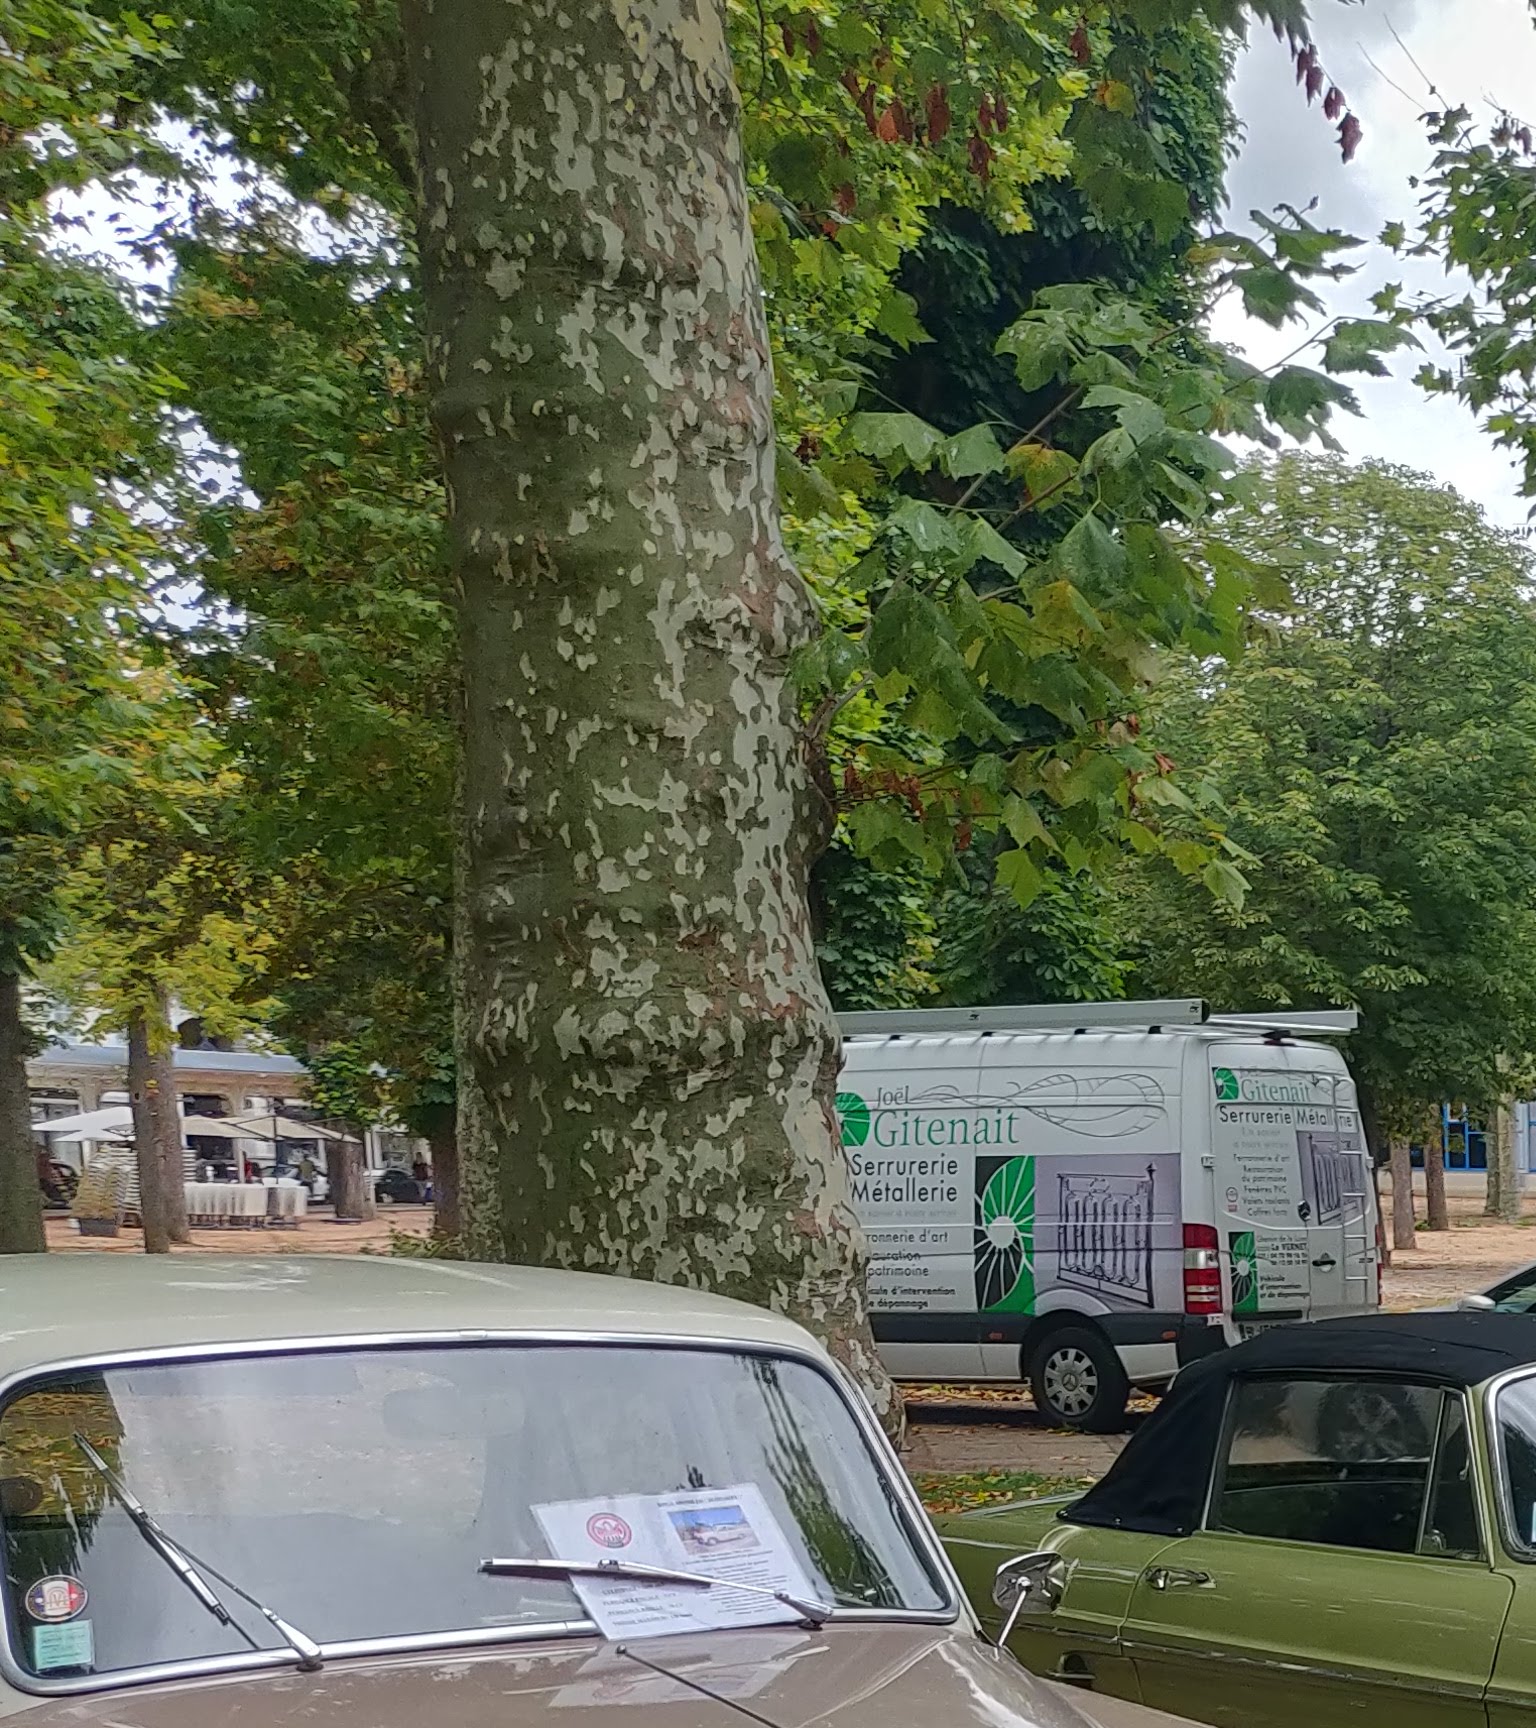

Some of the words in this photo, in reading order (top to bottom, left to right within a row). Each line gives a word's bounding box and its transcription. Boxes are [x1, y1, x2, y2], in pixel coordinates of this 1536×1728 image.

[877, 1085, 911, 1109] Joël
[1219, 1105, 1292, 1125] Serrurerie
[873, 1108, 1021, 1148] Gitenait
[852, 1152, 959, 1177] Serrurerie
[852, 1178, 958, 1203] Métallerie
[865, 1228, 915, 1243] ronnerie
[918, 1228, 949, 1243] d'art
